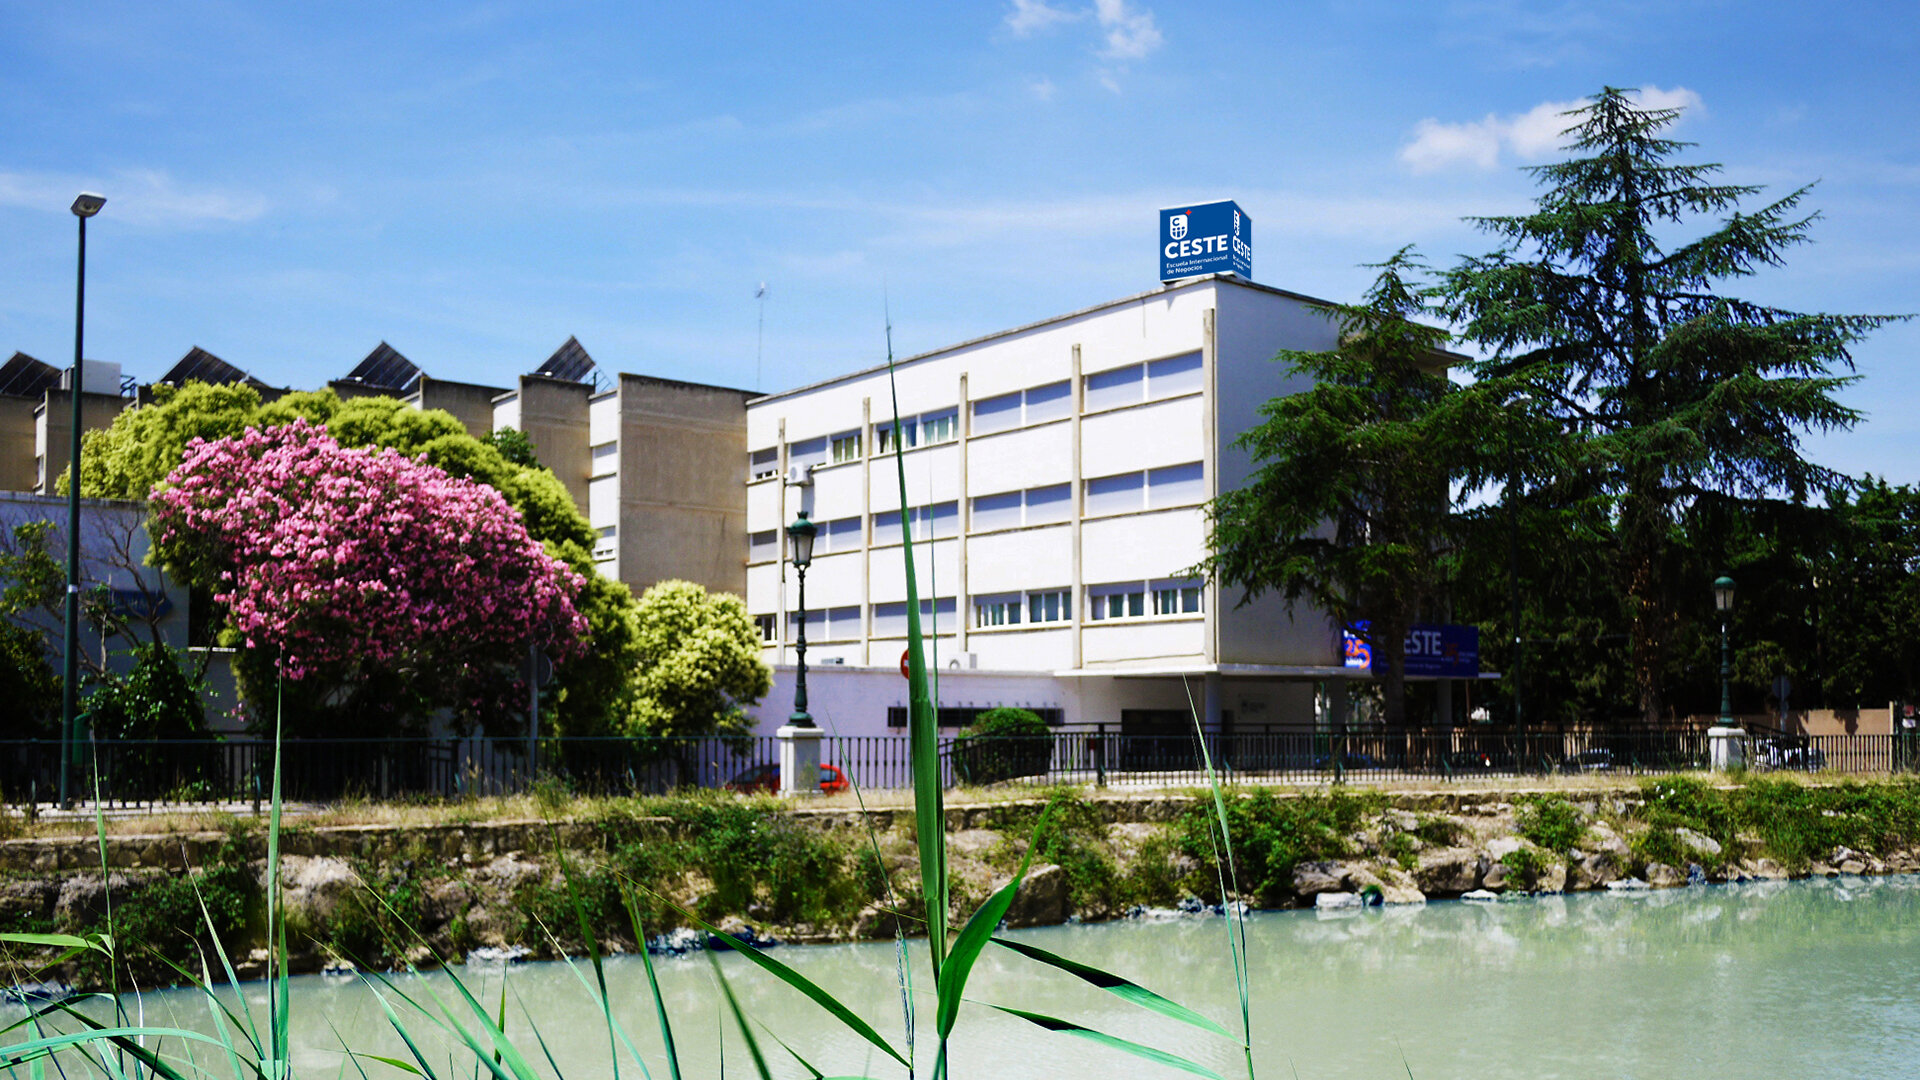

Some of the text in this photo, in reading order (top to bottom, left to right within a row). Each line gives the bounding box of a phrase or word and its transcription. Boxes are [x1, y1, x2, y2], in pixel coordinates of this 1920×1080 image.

[1165, 234, 1228, 259] CESTE
[1233, 235, 1251, 262] CESTE
[1166, 259, 1189, 269] Escuela
[1189, 254, 1228, 265] Internacional
[1175, 265, 1203, 274] Negocios
[1345, 639, 1371, 669] 25
[1403, 630, 1442, 656] ESTE
